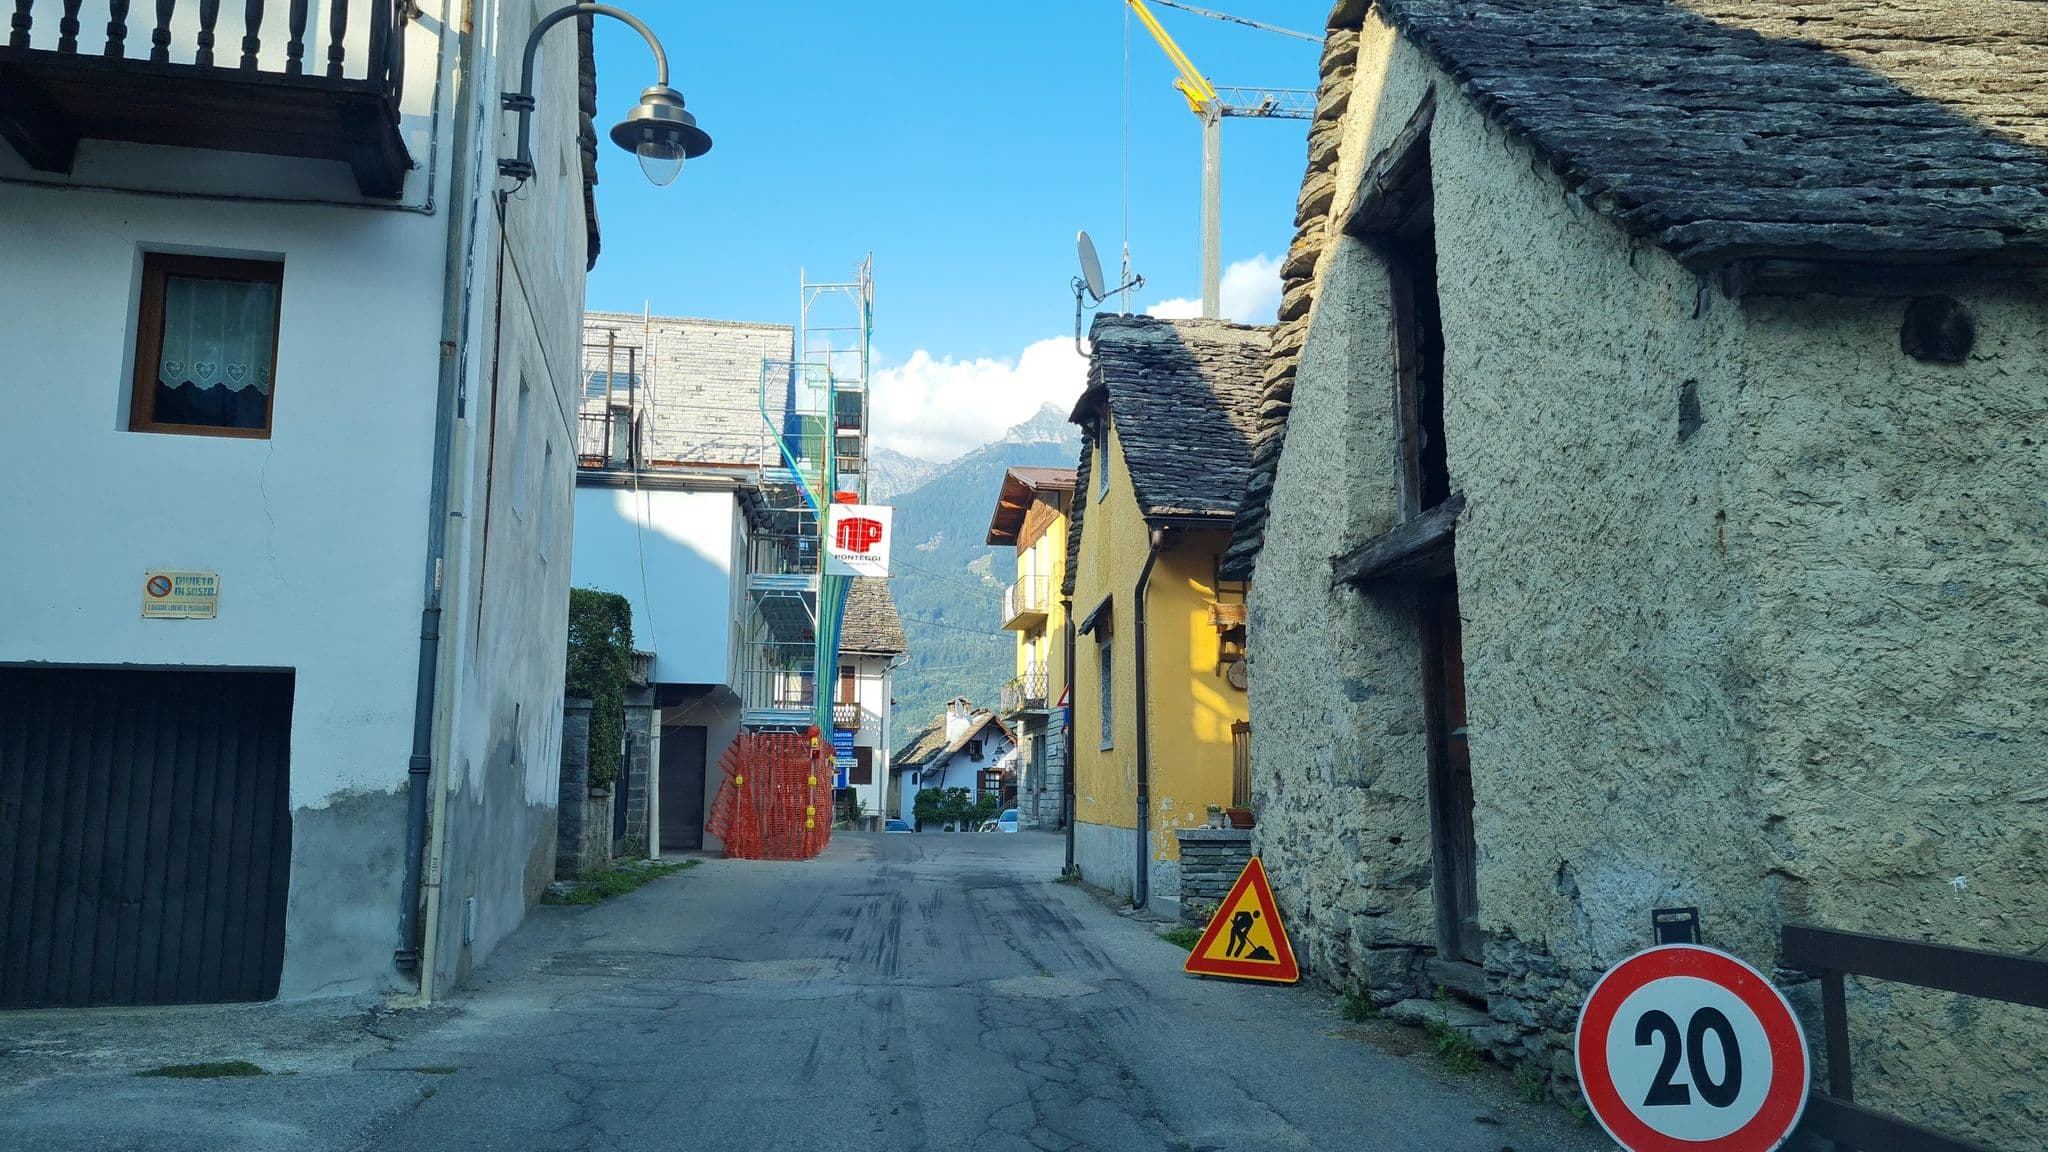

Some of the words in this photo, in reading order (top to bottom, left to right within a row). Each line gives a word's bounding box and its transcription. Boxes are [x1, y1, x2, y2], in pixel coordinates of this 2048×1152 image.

[175, 576, 214, 586] DIVIETO
[174, 587, 184, 596] DI
[185, 587, 214, 597] SOSTA
[1635, 1006, 1742, 1108] 20
